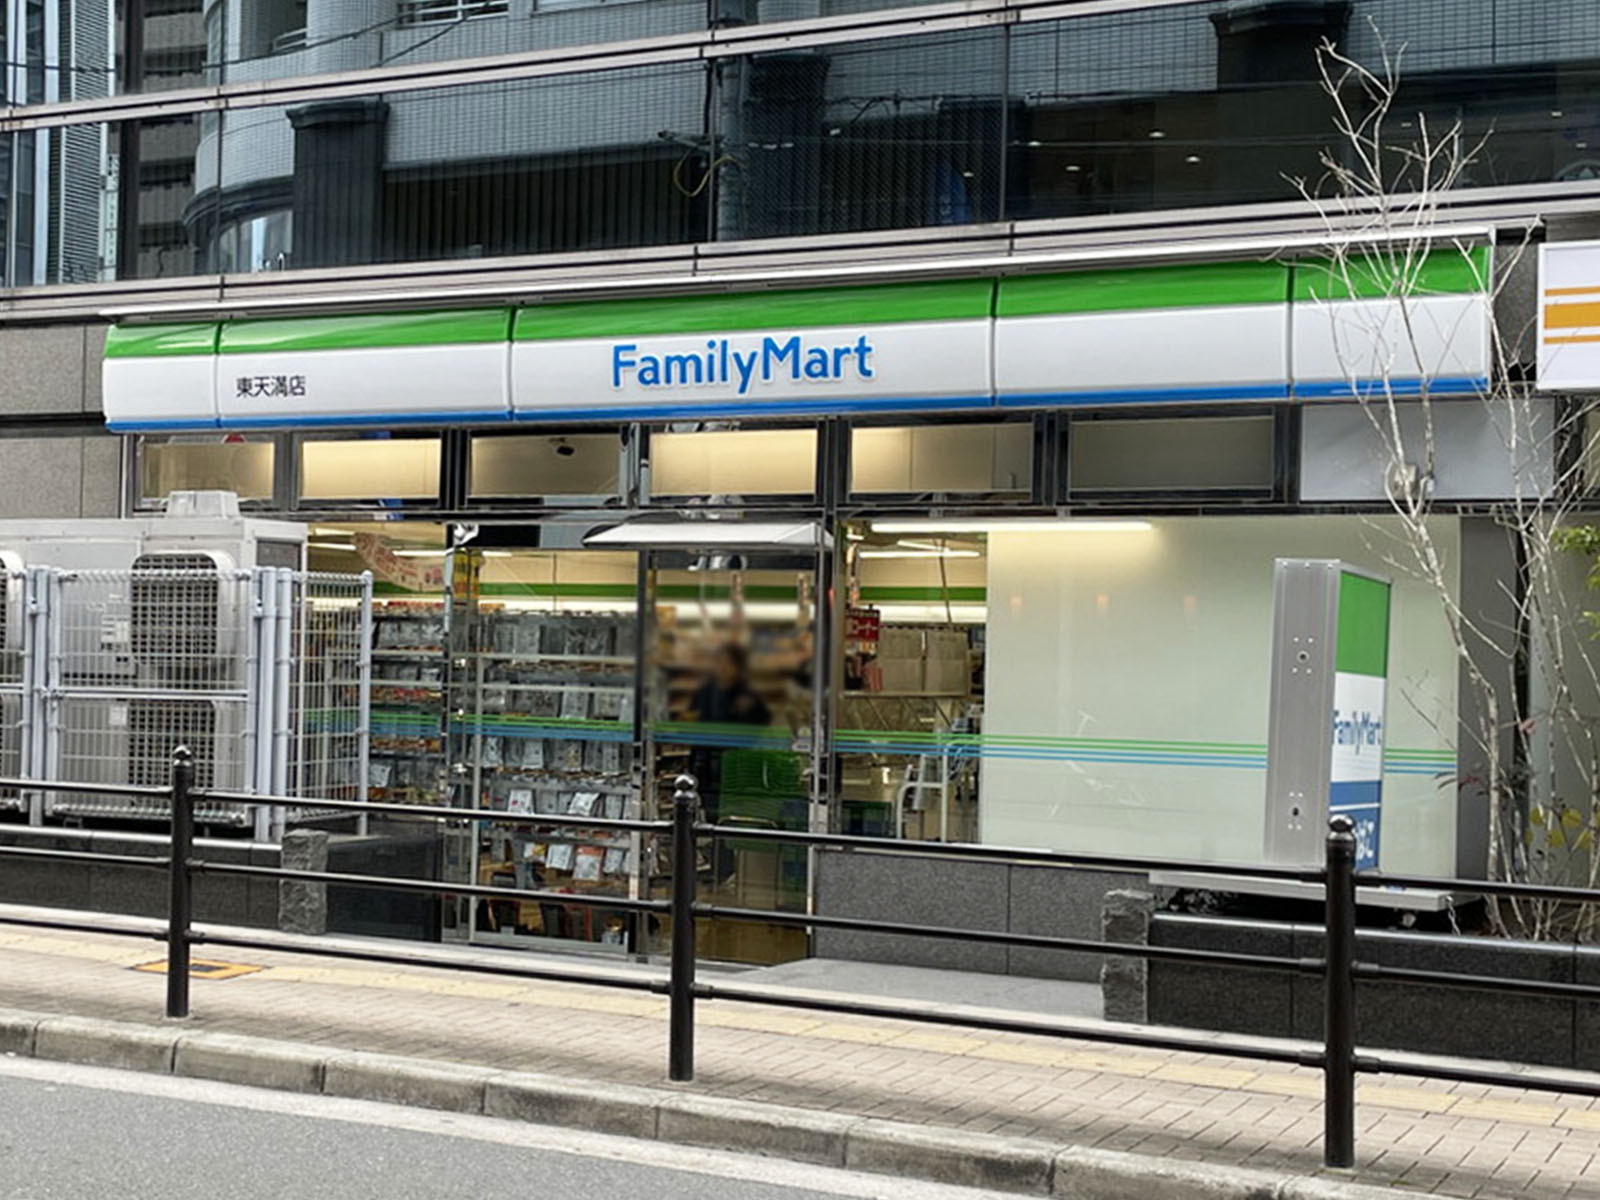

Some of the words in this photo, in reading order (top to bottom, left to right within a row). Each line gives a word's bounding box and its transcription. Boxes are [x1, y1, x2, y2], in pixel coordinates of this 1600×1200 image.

[613, 335, 873, 394] FamilyMart
[236, 375, 306, 398] 東天満店
